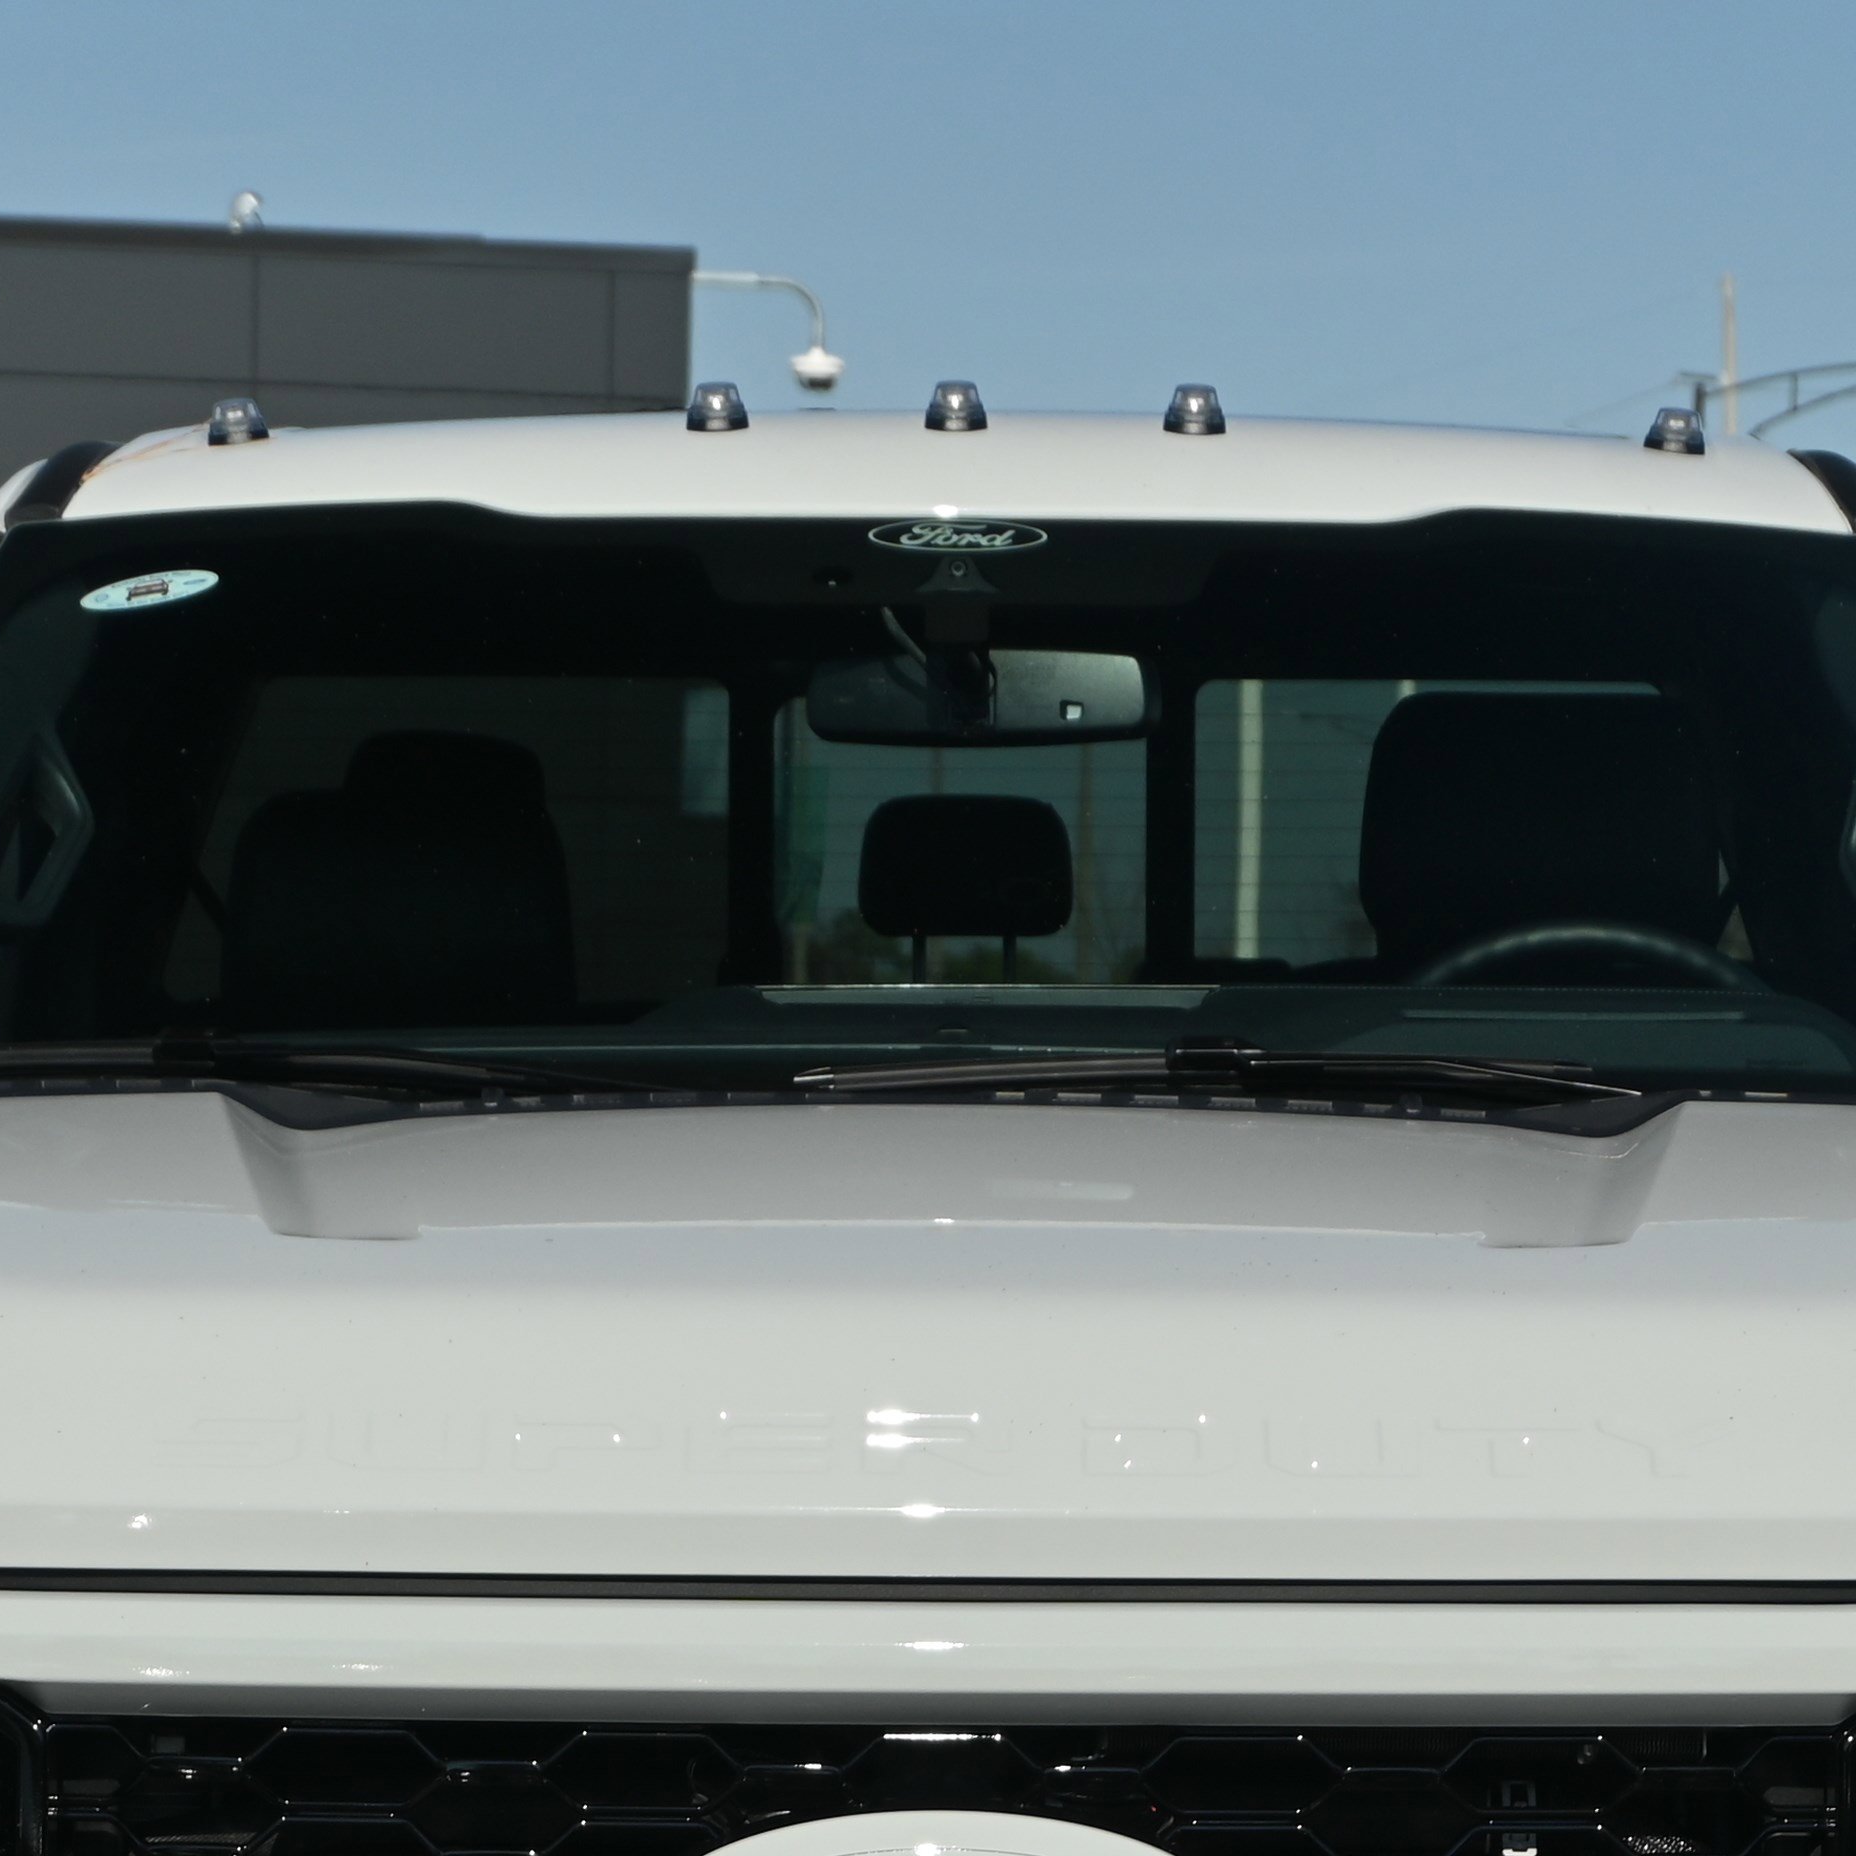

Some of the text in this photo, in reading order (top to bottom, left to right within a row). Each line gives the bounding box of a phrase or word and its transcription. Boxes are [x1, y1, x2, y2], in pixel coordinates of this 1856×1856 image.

[899, 523, 1017, 547] Ford
[152, 1409, 1738, 1479] SUPER DUTY
